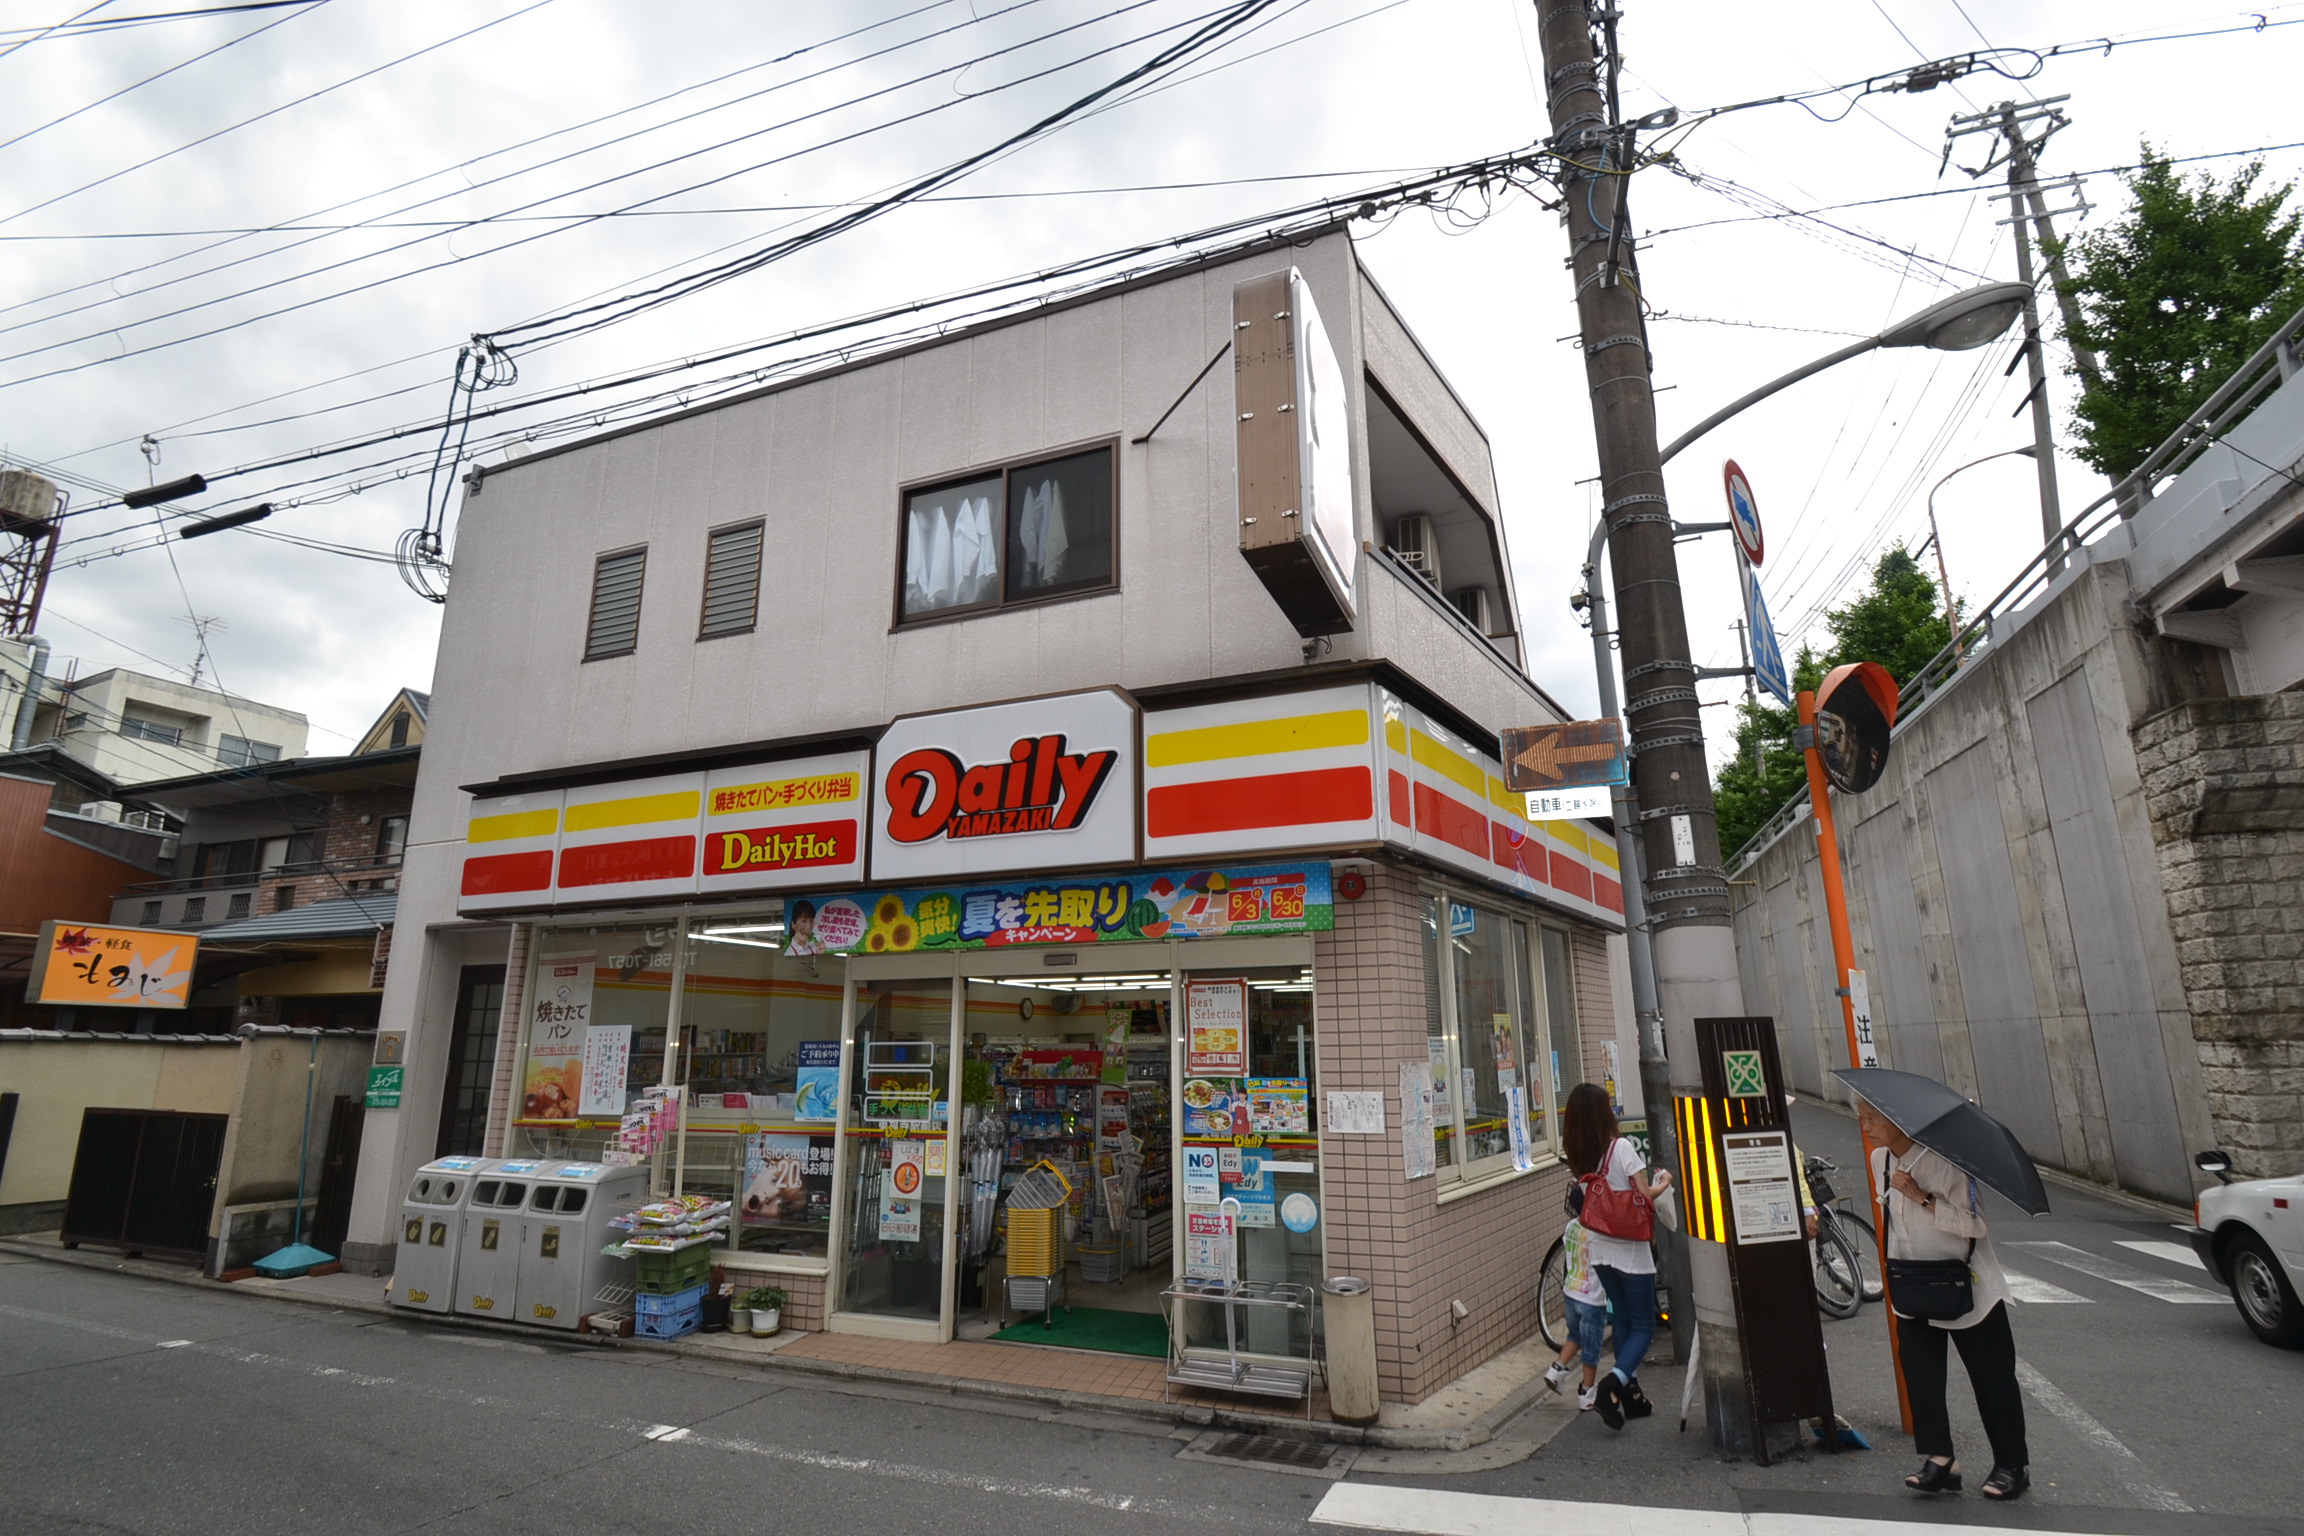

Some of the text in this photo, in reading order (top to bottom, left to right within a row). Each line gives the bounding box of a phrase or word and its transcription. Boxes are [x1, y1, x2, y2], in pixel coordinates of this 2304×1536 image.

[715, 777, 852, 812] 焼きたてパン・手づくり弁当
[886, 734, 1118, 842] Daily
[947, 806, 1053, 839] YAMAZAKI
[720, 832, 837, 870] DailyHot
[963, 885, 1128, 935] 夏を先取り
[1005, 926, 1077, 942] キャンペーン
[72, 953, 162, 997] もみじ
[1190, 997, 1213, 1008] Best
[535, 1000, 588, 1024] 焼きたて
[1194, 1008, 1242, 1019] Selection
[547, 1023, 572, 1040] パン
[1233, 1135, 1264, 1148] Daily
[748, 1145, 781, 1159] music
[1223, 1160, 1238, 1168] Edy
[408, 1288, 429, 1303] Daily
[473, 1296, 494, 1310] Daily
[534, 1304, 556, 1319] Daily
